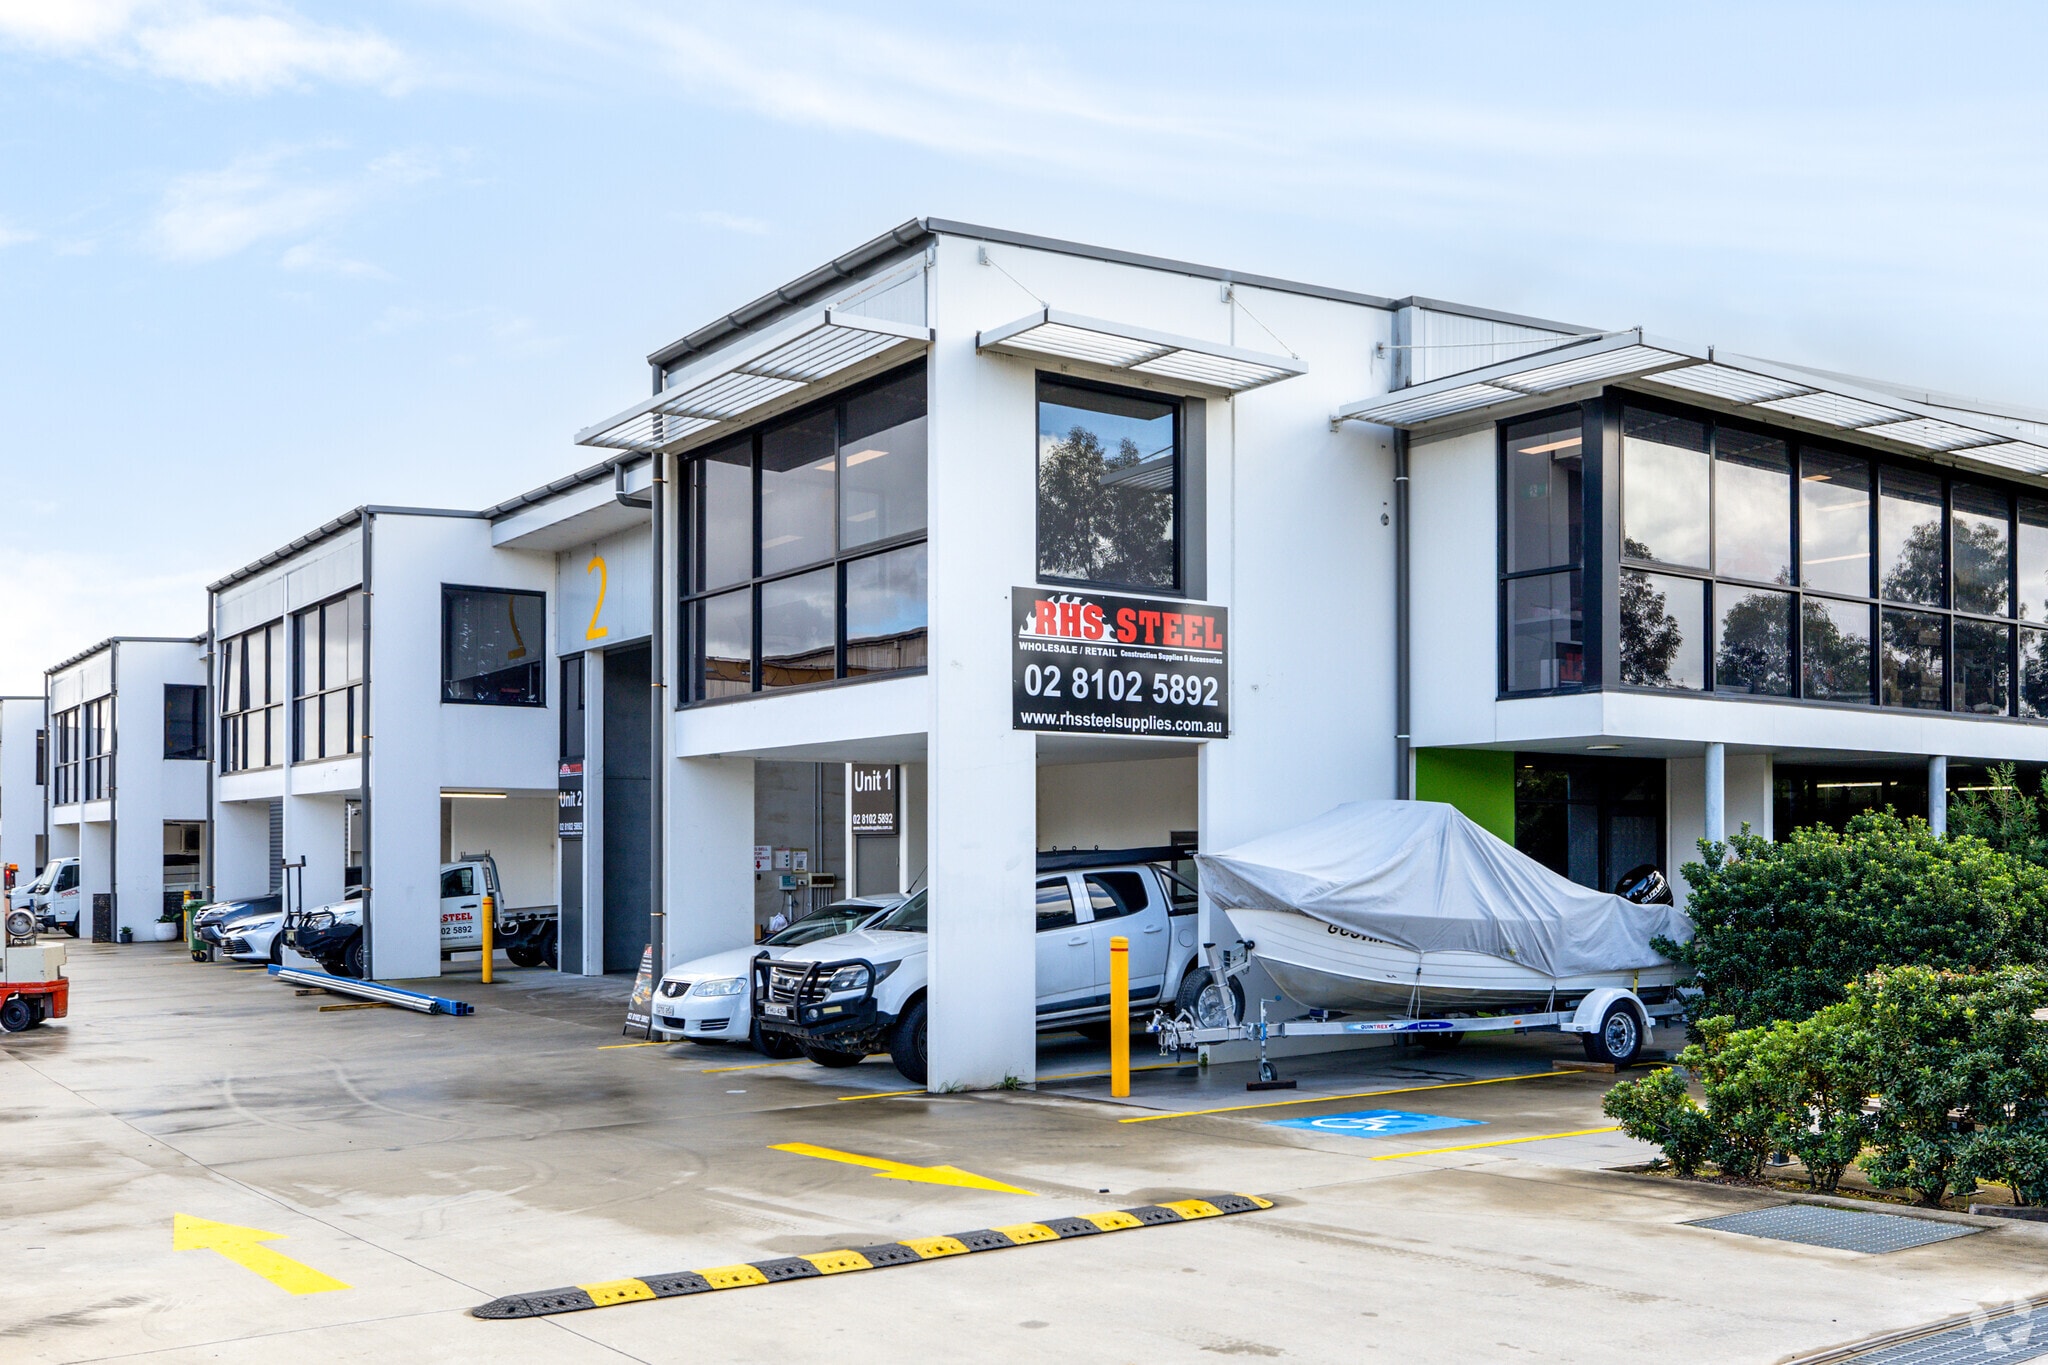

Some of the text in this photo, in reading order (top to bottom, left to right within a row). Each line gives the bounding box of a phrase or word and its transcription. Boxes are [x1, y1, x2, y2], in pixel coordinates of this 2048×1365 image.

[586, 555, 608, 641] 2
[1035, 599, 1223, 650] RHS STEEL
[1019, 641, 1078, 655] WHOLESALE
[1079, 646, 1083, 655] /
[1085, 646, 1118, 658] RETAIL
[1120, 649, 1157, 660] Construction
[1158, 652, 1183, 662] Supplies
[1189, 655, 1222, 665] Accessories
[1024, 663, 1219, 707] 02 8102 5892
[1020, 710, 1222, 733] www.rhssteelsupplies.com.au
[854, 768, 891, 792] Unit 1
[560, 790, 582, 807] Unit 2
[853, 813, 893, 825] 02 8102 5892
[1640, 879, 1665, 904] SUZUKI
[442, 912, 473, 923] STEEL
[453, 925, 472, 934] 5892
[1360, 1022, 1388, 1030] QUINTREX
